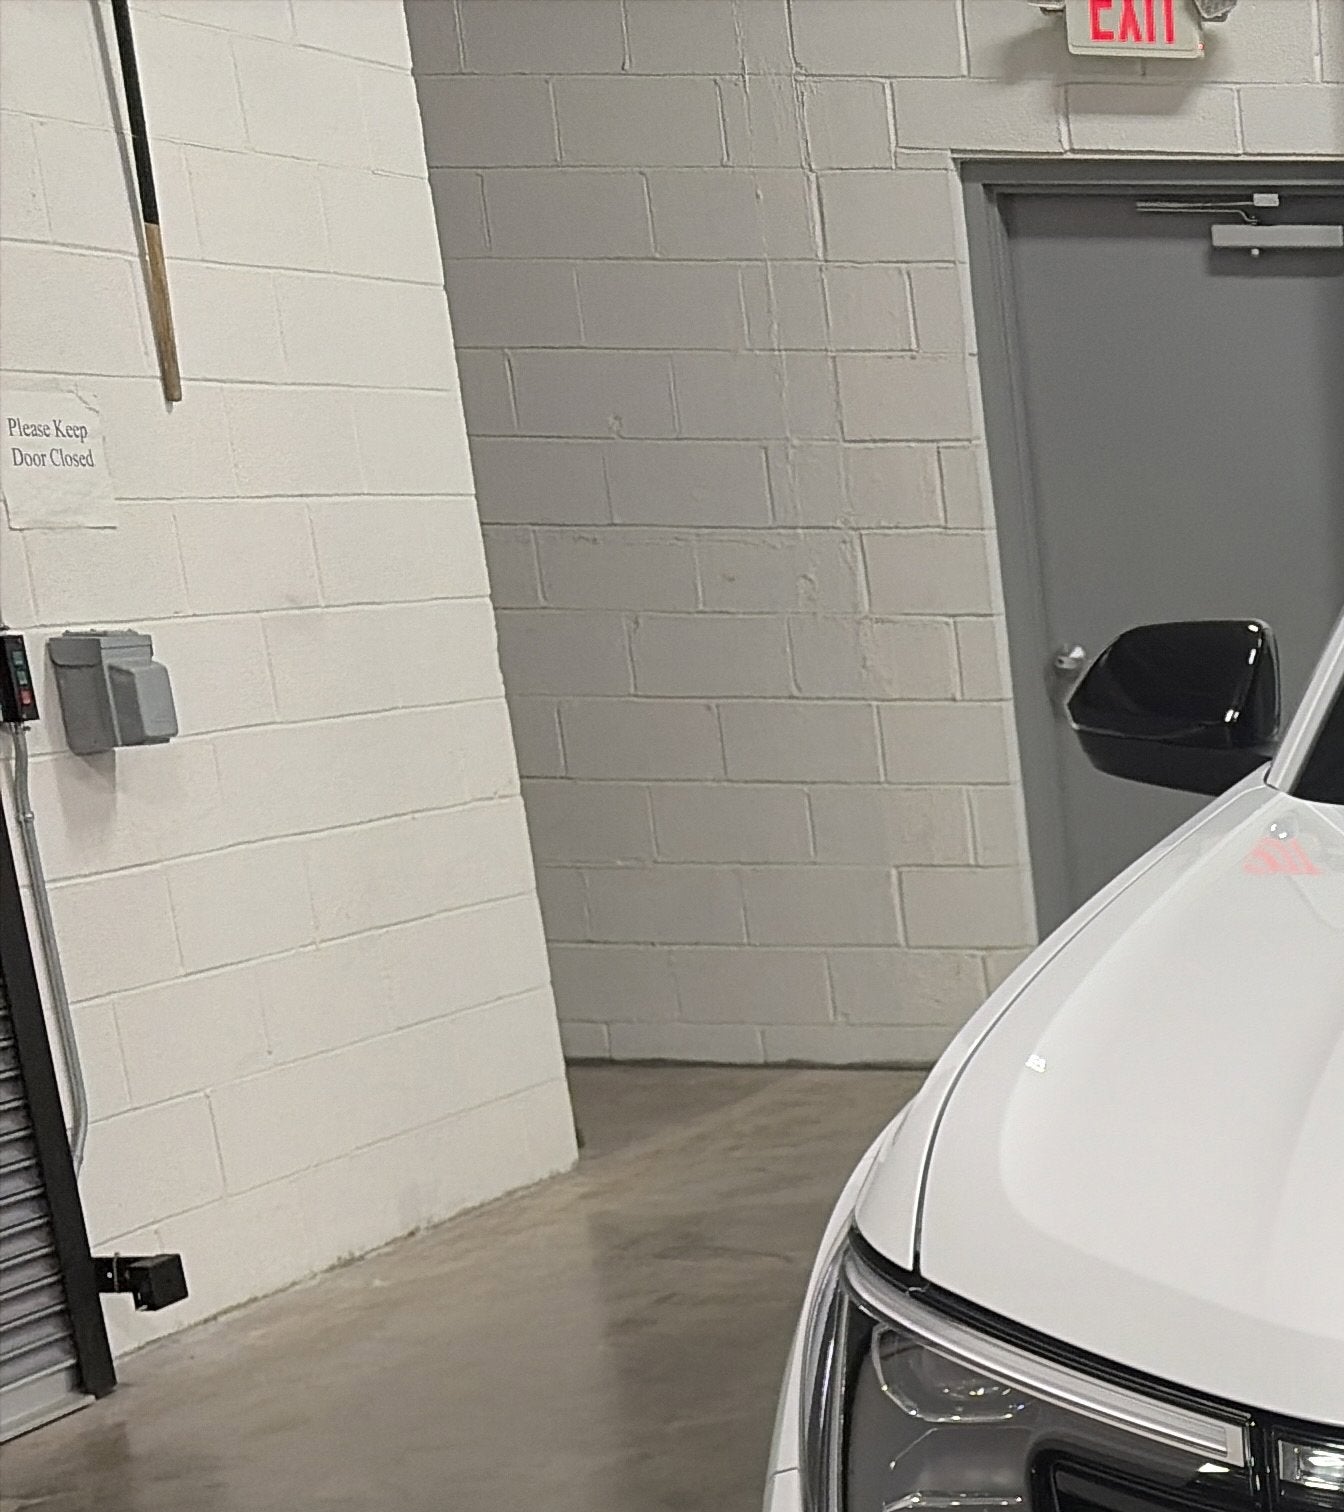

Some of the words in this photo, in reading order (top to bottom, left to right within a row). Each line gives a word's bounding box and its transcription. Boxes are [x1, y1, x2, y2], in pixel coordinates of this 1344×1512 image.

[8, 418, 50, 437] Please
[53, 420, 88, 443] Keep
[12, 448, 46, 467] Door
[50, 448, 95, 467] Closed
